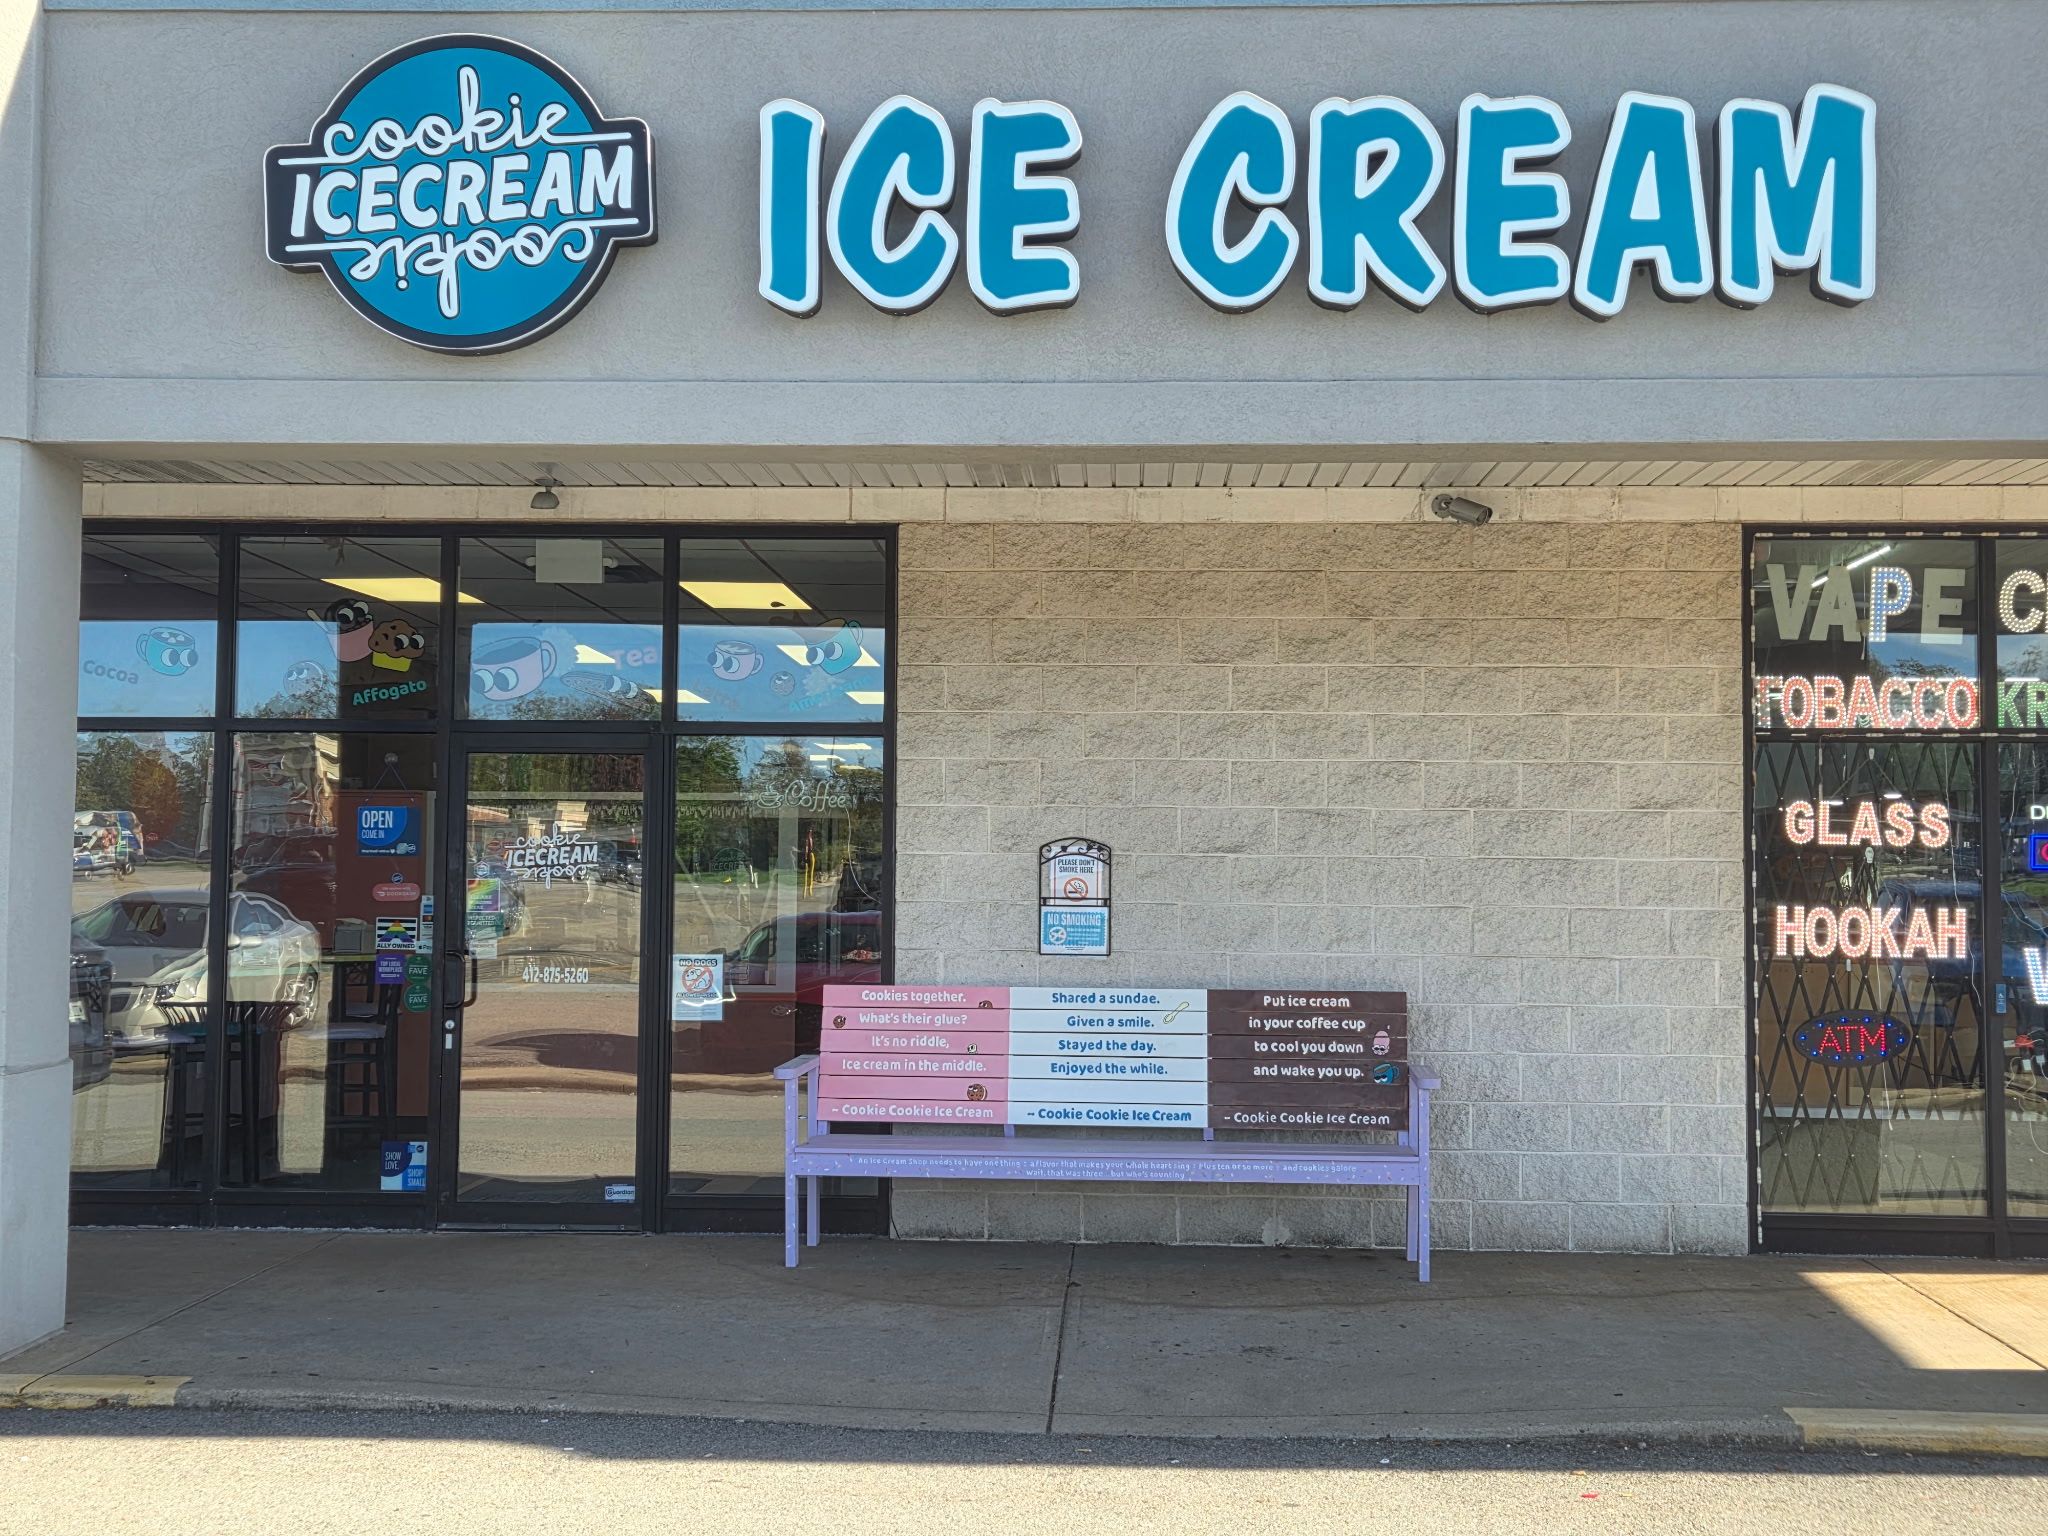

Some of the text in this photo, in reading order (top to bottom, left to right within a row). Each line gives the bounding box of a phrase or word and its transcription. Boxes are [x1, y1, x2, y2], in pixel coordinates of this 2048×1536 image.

[278, 65, 632, 165] cookie
[289, 145, 634, 238] ICECREAM
[759, 83, 1877, 317] ICE CREAM
[1766, 563, 1966, 645] VAPE
[607, 646, 659, 670] Tea
[83, 659, 140, 685] Cocoa
[352, 678, 428, 706] Affogato
[1754, 676, 1979, 729] TOBACCO
[785, 779, 847, 812] Coffee
[361, 810, 393, 828] OPEN
[1785, 800, 1950, 848] GLASS
[361, 829, 385, 839] COME IN
[505, 823, 598, 848] cookie
[507, 845, 598, 866] ICECREAM
[1047, 913, 1101, 926] NO SMOKING
[1776, 905, 1967, 958] HOOKAH
[694, 959, 717, 967] DOGS
[408, 967, 428, 975] FAVE
[522, 966, 589, 984] 412-875-5260
[409, 995, 428, 1004] FAVE
[861, 989, 966, 1004] Cookies together.
[1052, 992, 1160, 1004] Shared a sundae.
[1263, 995, 1350, 1007] Put ice cream
[859, 1012, 968, 1026] What's their glue?
[1066, 1015, 1154, 1027] Given a smile.
[1248, 1016, 1366, 1031] in your coffee cup
[871, 1036, 949, 1049] It's no riddle,
[1819, 1023, 1886, 1054] ATM
[1058, 1039, 1157, 1053] Stayed the day.
[1254, 1040, 1364, 1054] to cool you down
[842, 1059, 987, 1072] Ice cream in the middle.
[1050, 1062, 1168, 1076] Enjoyed the while.
[1253, 1064, 1364, 1079] and wake you up.
[842, 1104, 886, 1115] Cookie
[888, 1104, 931, 1116] Cookie
[934, 1105, 953, 1116] Ice
[955, 1106, 993, 1118] Cream
[1038, 1108, 1083, 1120] Cookie
[1086, 1108, 1129, 1120] Cookie
[1132, 1109, 1150, 1120] Ice
[1152, 1110, 1192, 1121] Cream
[1233, 1111, 1277, 1123] Cookie
[1280, 1112, 1324, 1124] Cookie
[1327, 1112, 1345, 1124] Ice
[1349, 1113, 1390, 1125] Cream
[384, 1151, 401, 1160] SHOW
[384, 1161, 400, 1170] LOVE.
[882, 1157, 907, 1165] Cream
[929, 1158, 953, 1166] needs
[954, 1158, 962, 1166] to
[964, 1158, 983, 1166] have
[984, 1159, 998, 1167] one
[1000, 1159, 1020, 1168] thing
[1061, 1160, 1077, 1168] that
[1078, 1160, 1104, 1168] makes
[1105, 1161, 1124, 1170] your
[1125, 1161, 1149, 1169] whole
[1150, 1161, 1171, 1169] heart
[1173, 1162, 1190, 1171] sing
[1298, 1163, 1329, 1172] cookies
[1331, 1164, 1357, 1173] galore
[407, 1169, 423, 1178] SHOP
[1025, 1168, 1046, 1177] Wait,
[1047, 1169, 1064, 1177] that
[1149, 1171, 1185, 1180] counting
[407, 1178, 426, 1187] SMALL
[606, 1187, 634, 1197] Guardian
